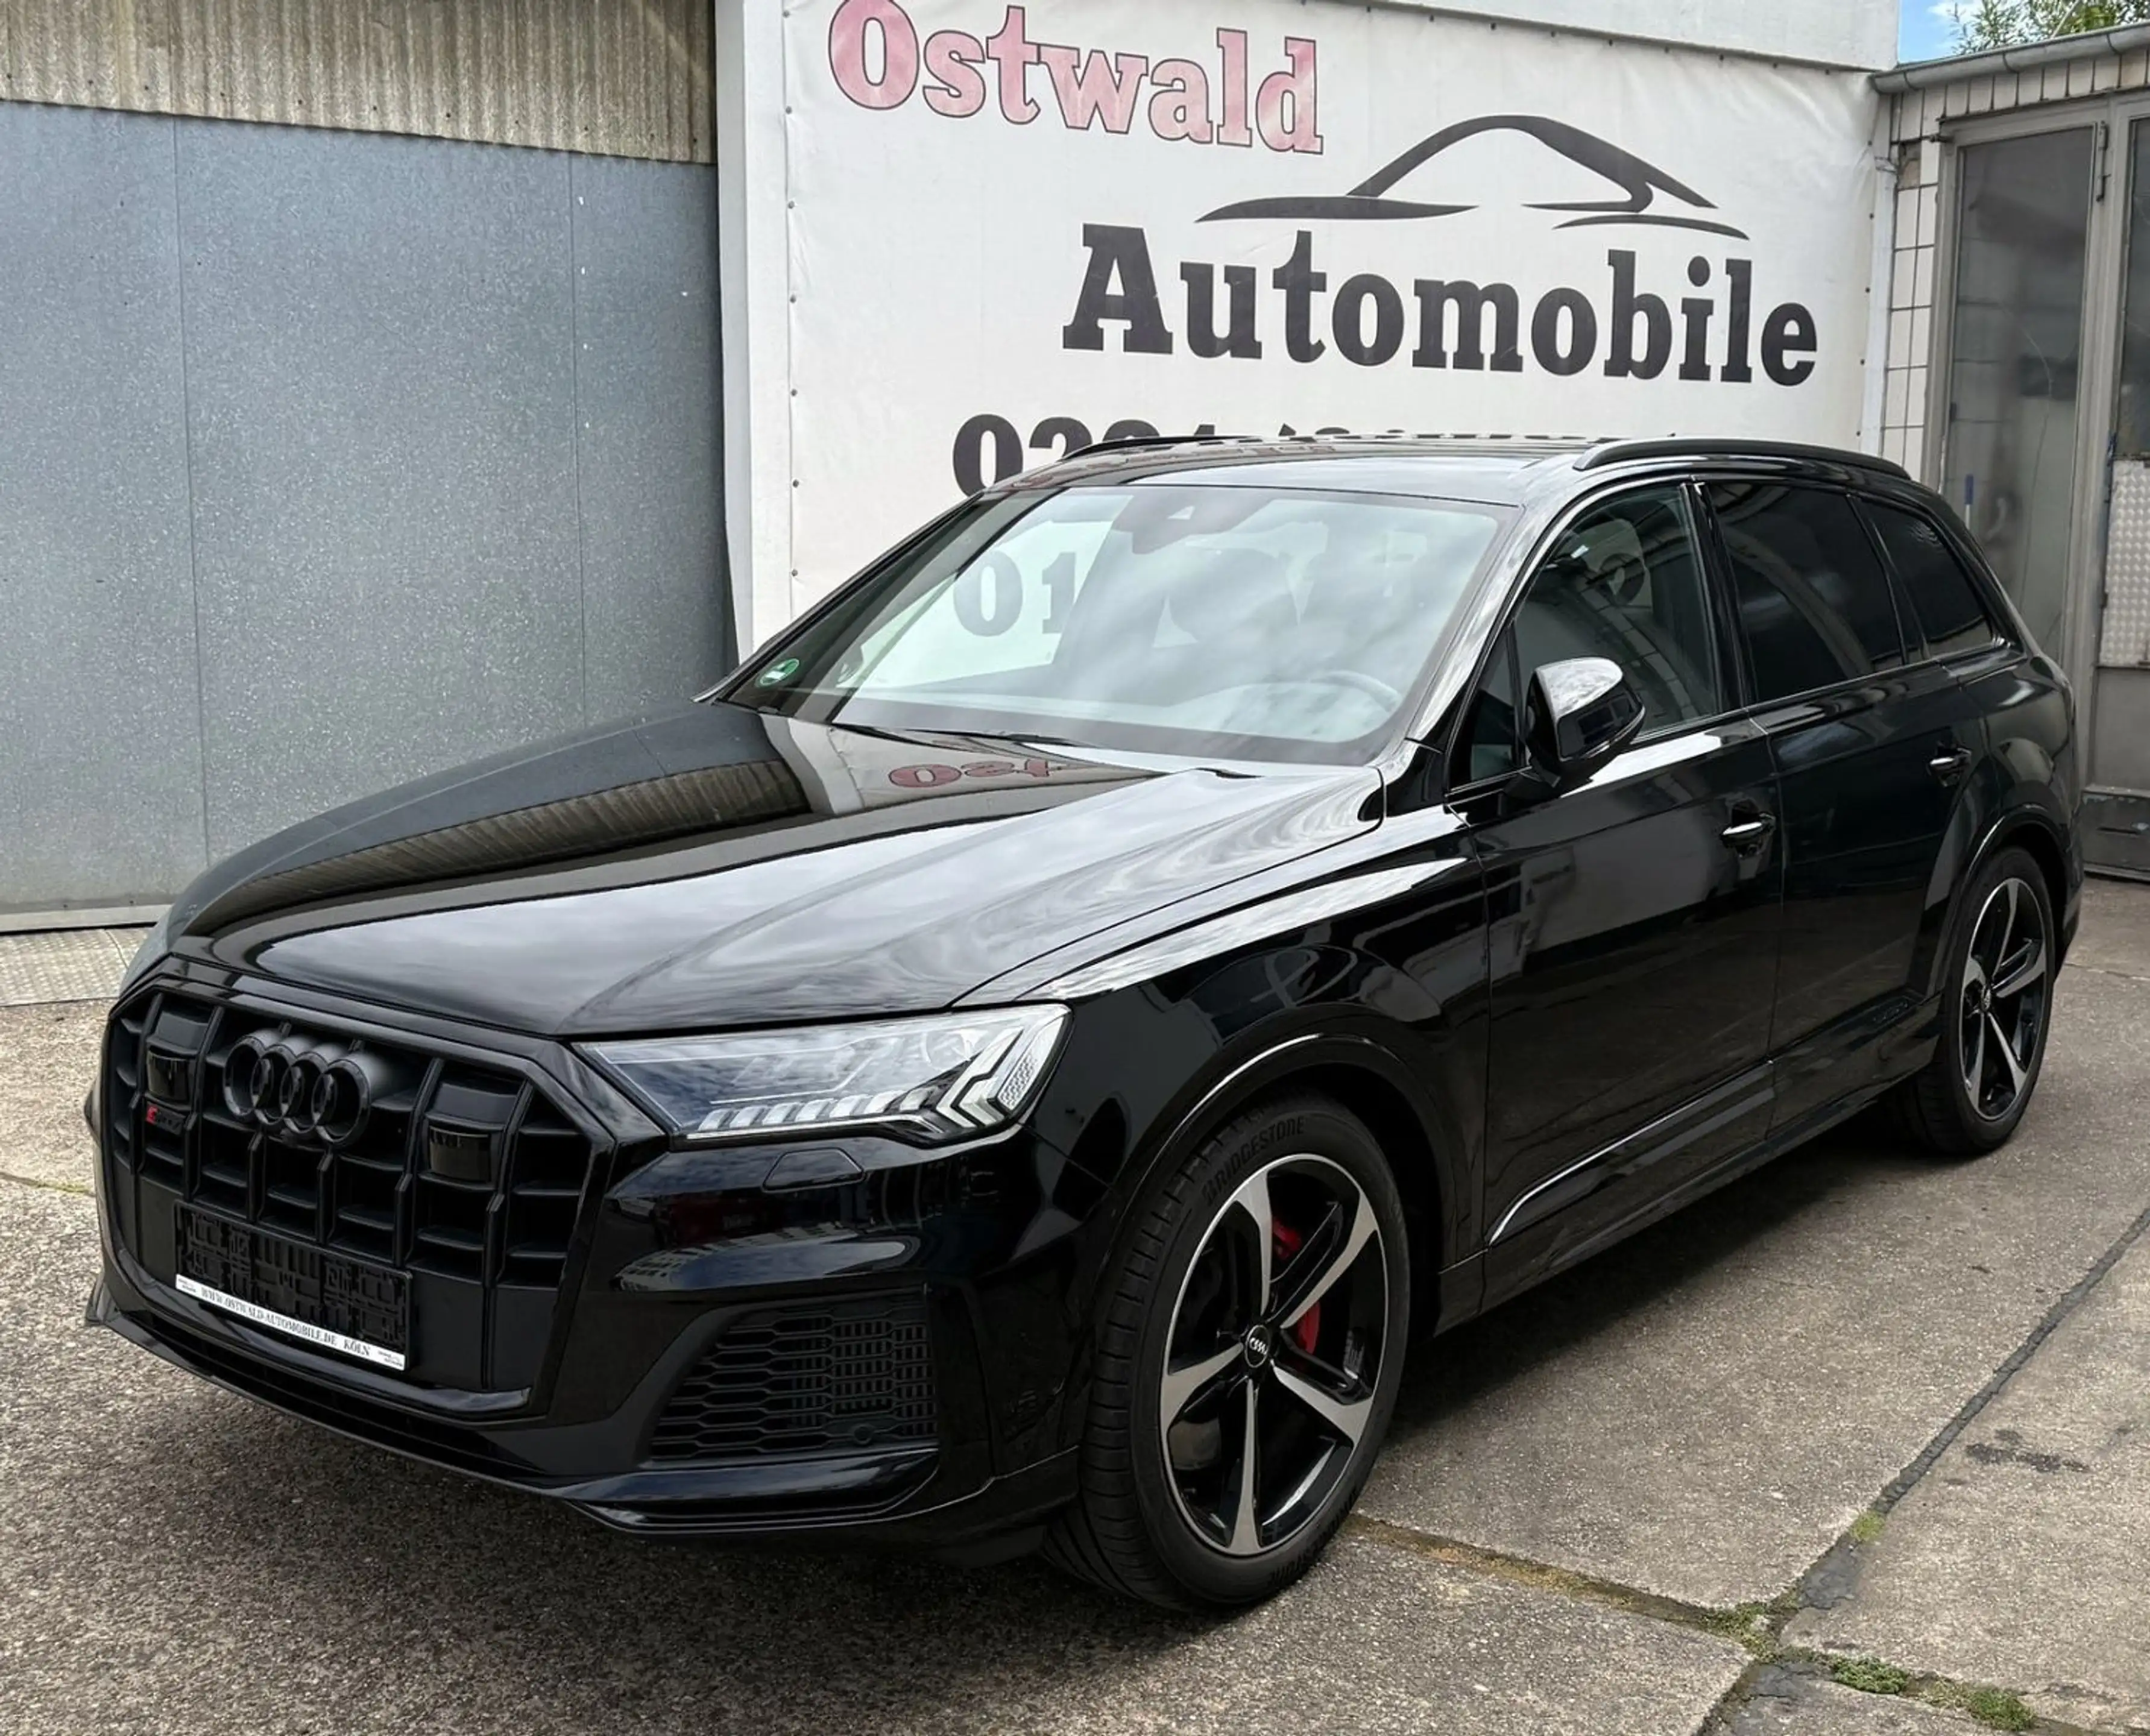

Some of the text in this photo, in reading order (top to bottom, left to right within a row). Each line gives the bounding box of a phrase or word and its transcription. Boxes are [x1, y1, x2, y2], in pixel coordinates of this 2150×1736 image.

[828, 0, 1323, 155] Ostwald
[1063, 223, 1817, 386] Automobile
[1201, 1116, 1306, 1206] BRIDGESTONE
[343, 1339, 371, 1356] KÖLN
